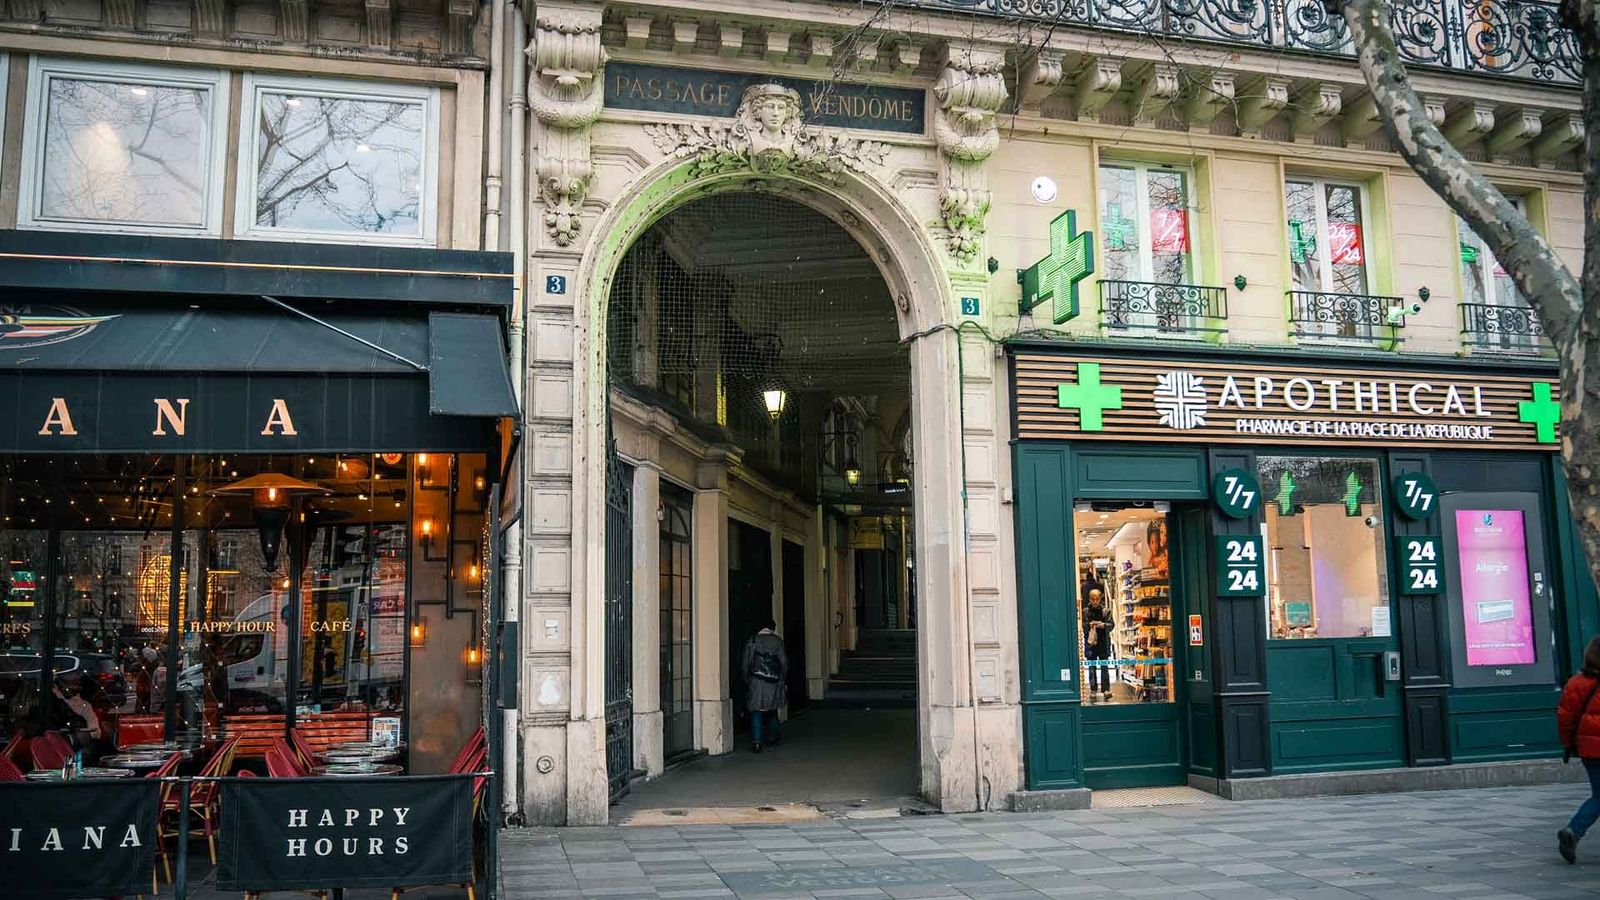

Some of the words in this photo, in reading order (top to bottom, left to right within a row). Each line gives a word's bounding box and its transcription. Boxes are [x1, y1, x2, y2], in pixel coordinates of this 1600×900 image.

[615, 75, 732, 106] PASSAGE
[550, 276, 561, 293] 3
[966, 298, 975, 314] 3
[1217, 375, 1492, 417] APOTHICAL
[1236, 418, 1311, 434] PHARMACIE
[1314, 421, 1333, 435] DE
[1334, 421, 1350, 436] LA
[1351, 422, 1388, 437] PLACE
[1390, 423, 1408, 438] DE
[1409, 424, 1425, 438] LA
[1426, 424, 1494, 440] REPUBLIQUE
[1224, 476, 1255, 509] 7/7
[1404, 480, 1433, 511] 7/7
[1226, 541, 1257, 561] 24
[1407, 541, 1436, 561] 24
[1228, 570, 1259, 591] 24
[1409, 569, 1438, 589] 24
[190, 621, 233, 633] HAPPY
[237, 622, 276, 633] HOUR
[310, 617, 353, 633] CAFÉ
[287, 807, 410, 828] HAPPY
[8, 823, 142, 853] IANA
[286, 836, 409, 858] HOURS
